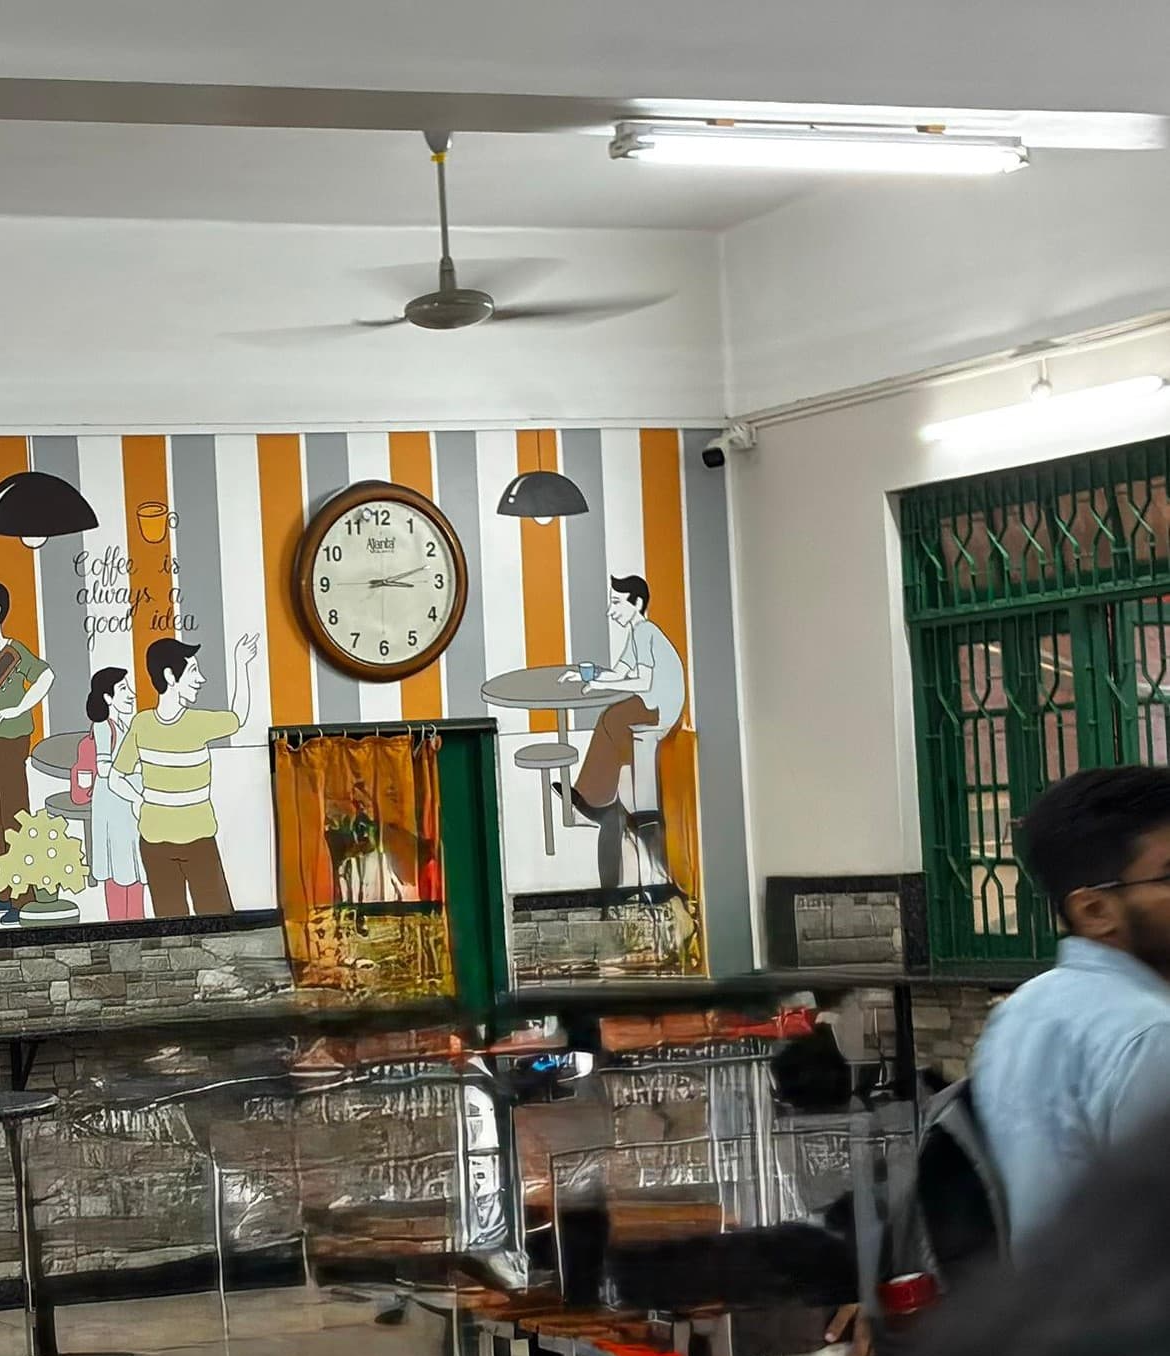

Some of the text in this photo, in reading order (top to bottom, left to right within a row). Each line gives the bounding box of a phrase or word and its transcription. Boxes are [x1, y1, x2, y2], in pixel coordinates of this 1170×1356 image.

[373, 510, 391, 526] 12
[406, 518, 414, 534] 1
[344, 519, 361, 536] 11
[323, 545, 342, 562] 10
[425, 541, 436, 557] 2
[73, 545, 180, 587] Coffee is
[319, 577, 330, 593] 9
[434, 573, 444, 590] 3
[76, 580, 183, 617] always a
[328, 609, 338, 625] 8
[428, 606, 437, 622] 4
[83, 606, 199, 651] good idea
[350, 632, 360, 649] 7
[407, 630, 418, 647] 5
[379, 640, 390, 656] 6
